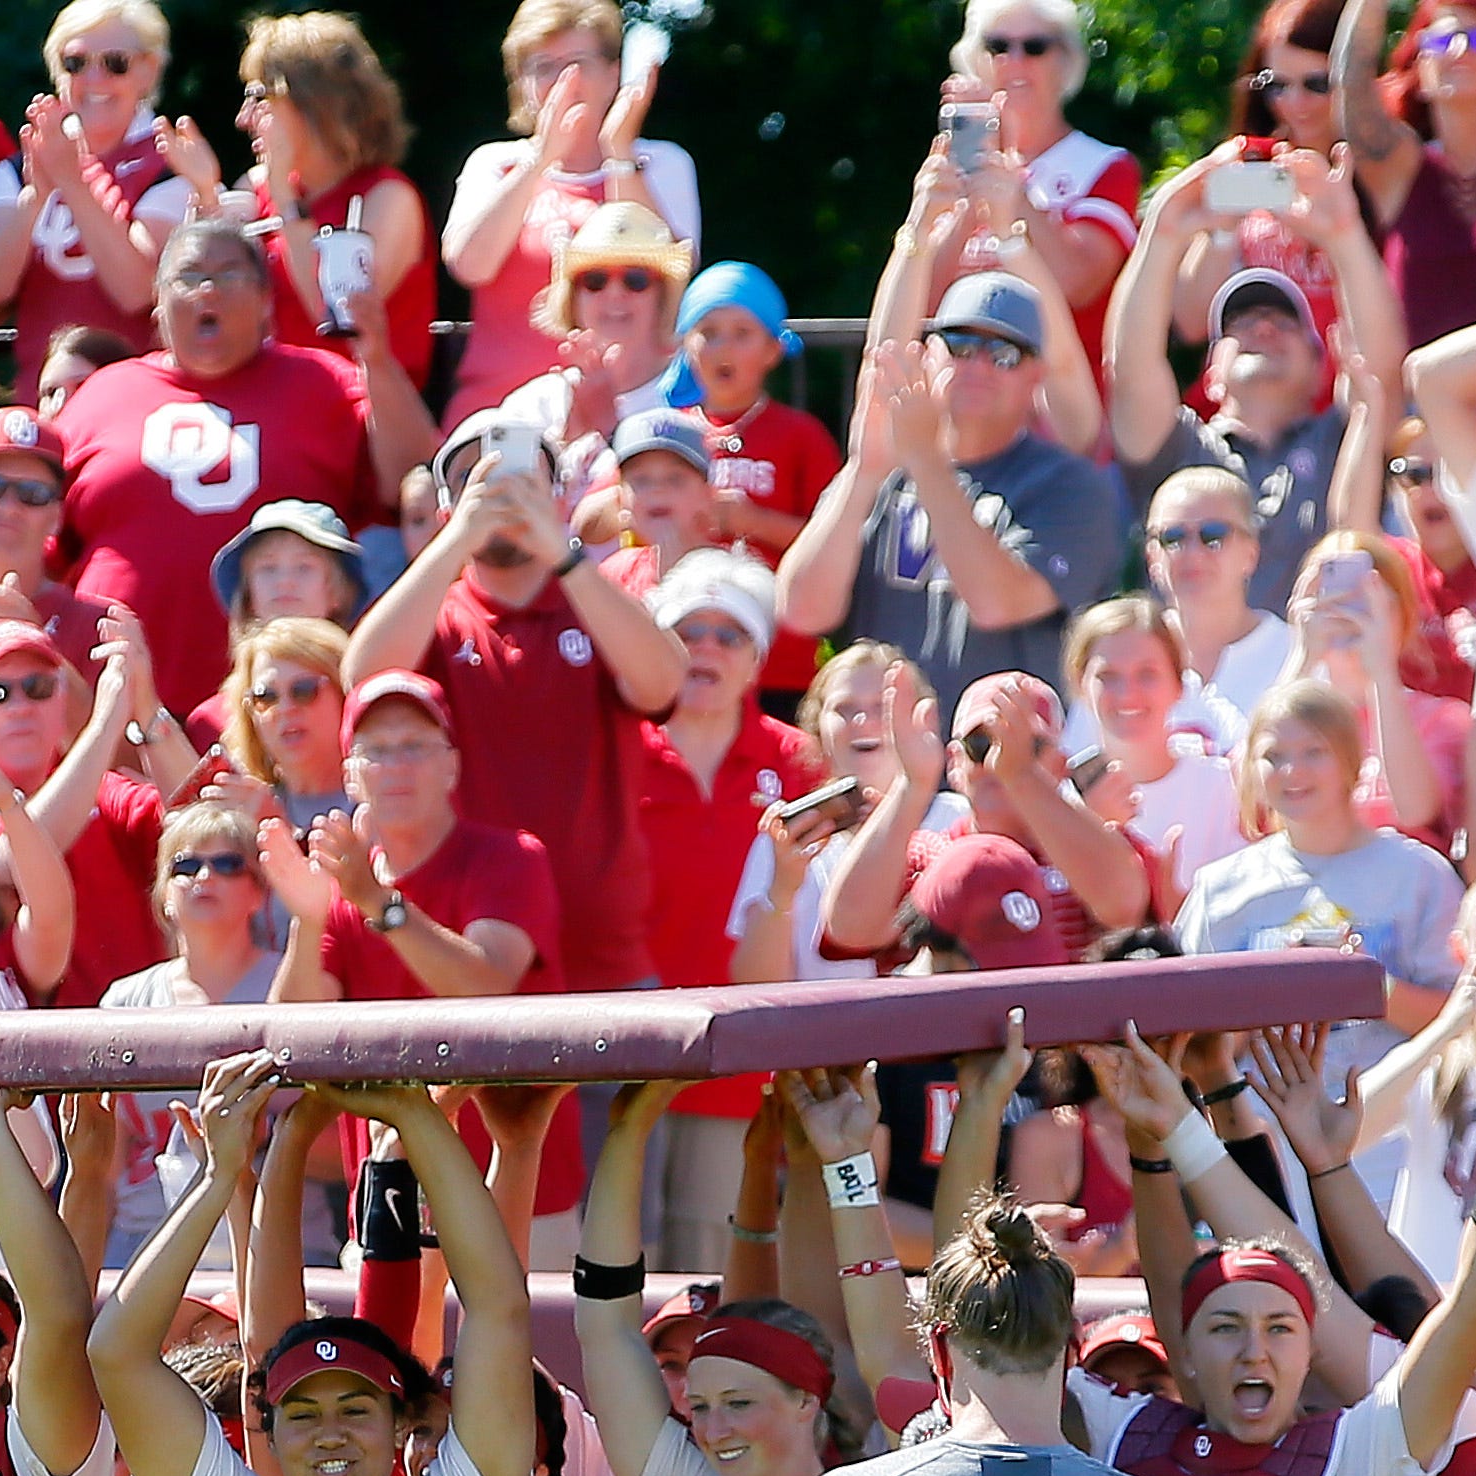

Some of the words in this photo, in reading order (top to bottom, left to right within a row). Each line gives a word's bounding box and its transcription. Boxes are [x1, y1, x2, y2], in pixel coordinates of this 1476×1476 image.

[142, 402, 259, 514] OU
[316, 1341, 337, 1361] OU
[1194, 1435, 1212, 1457] OU
